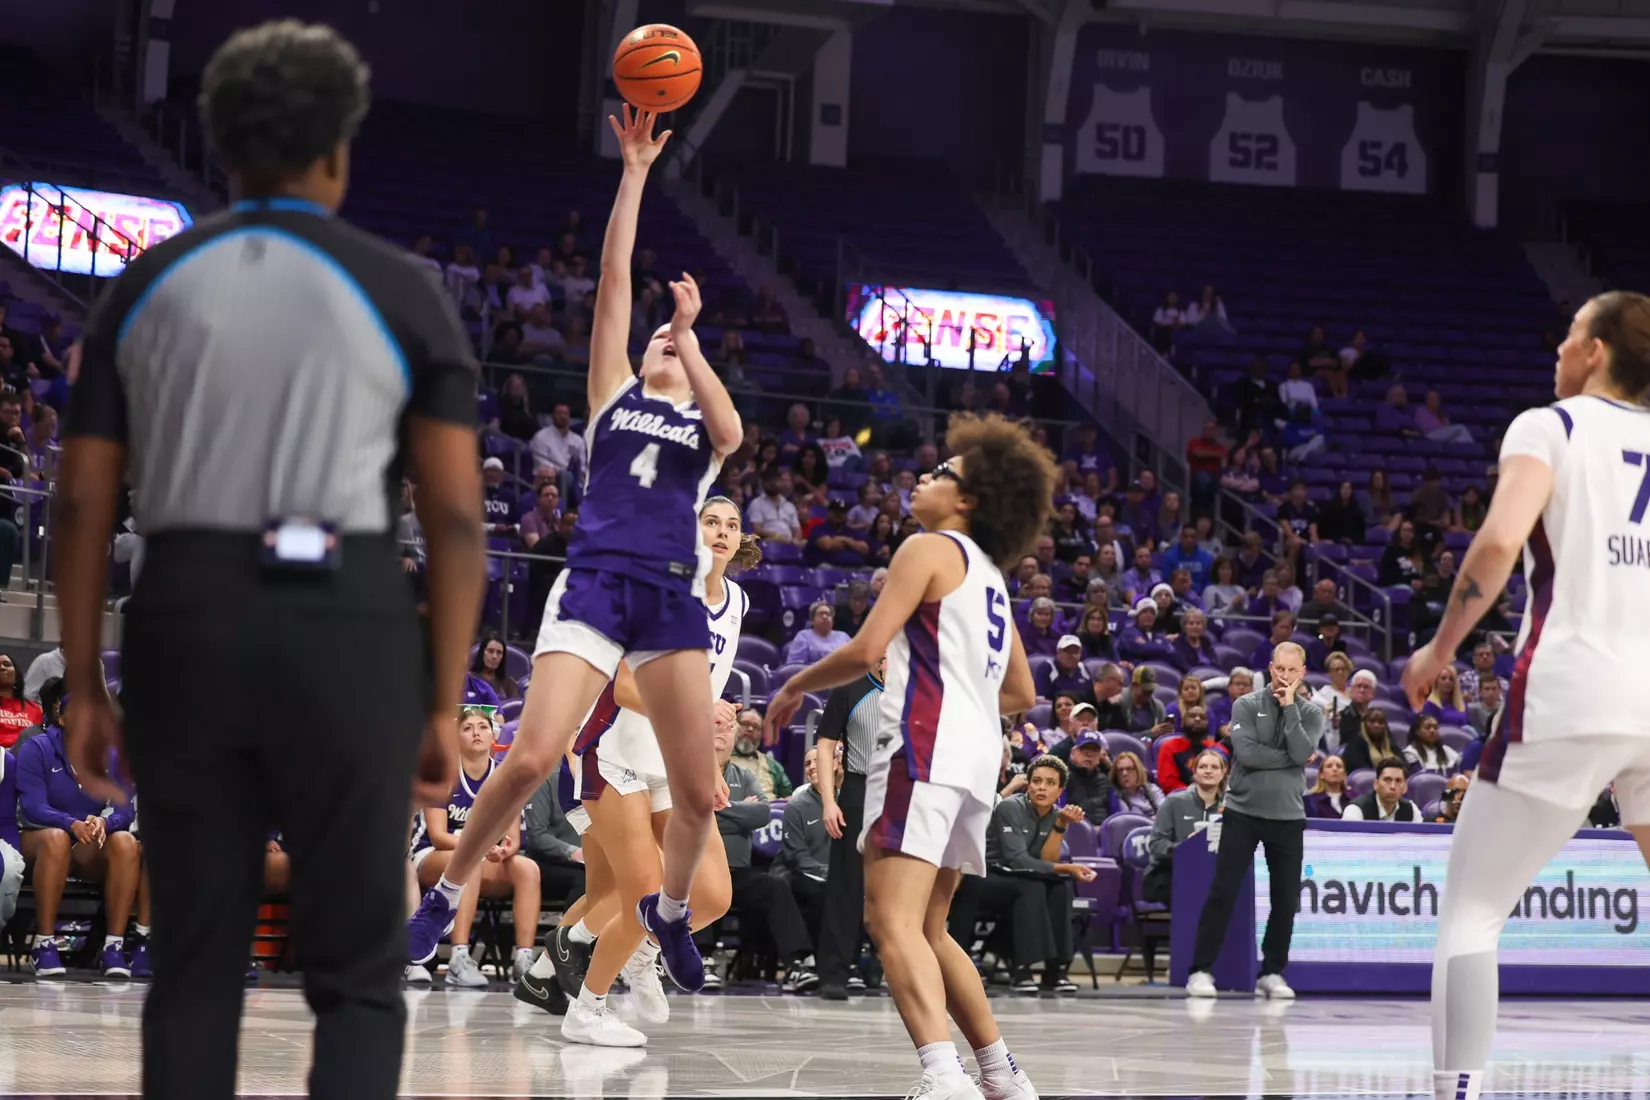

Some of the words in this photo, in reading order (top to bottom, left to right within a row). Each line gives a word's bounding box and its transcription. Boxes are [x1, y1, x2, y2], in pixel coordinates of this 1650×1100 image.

[1361, 67, 1412, 89] CASH
[1095, 123, 1146, 162] 50
[1228, 131, 1279, 171] 52
[1358, 140, 1408, 179] 54
[610, 407, 699, 450] Wildcats
[629, 442, 661, 489] 4
[1622, 450, 1650, 524] 7
[484, 500, 509, 515] TCU
[1608, 534, 1650, 569] SUA
[986, 586, 1006, 652] 5
